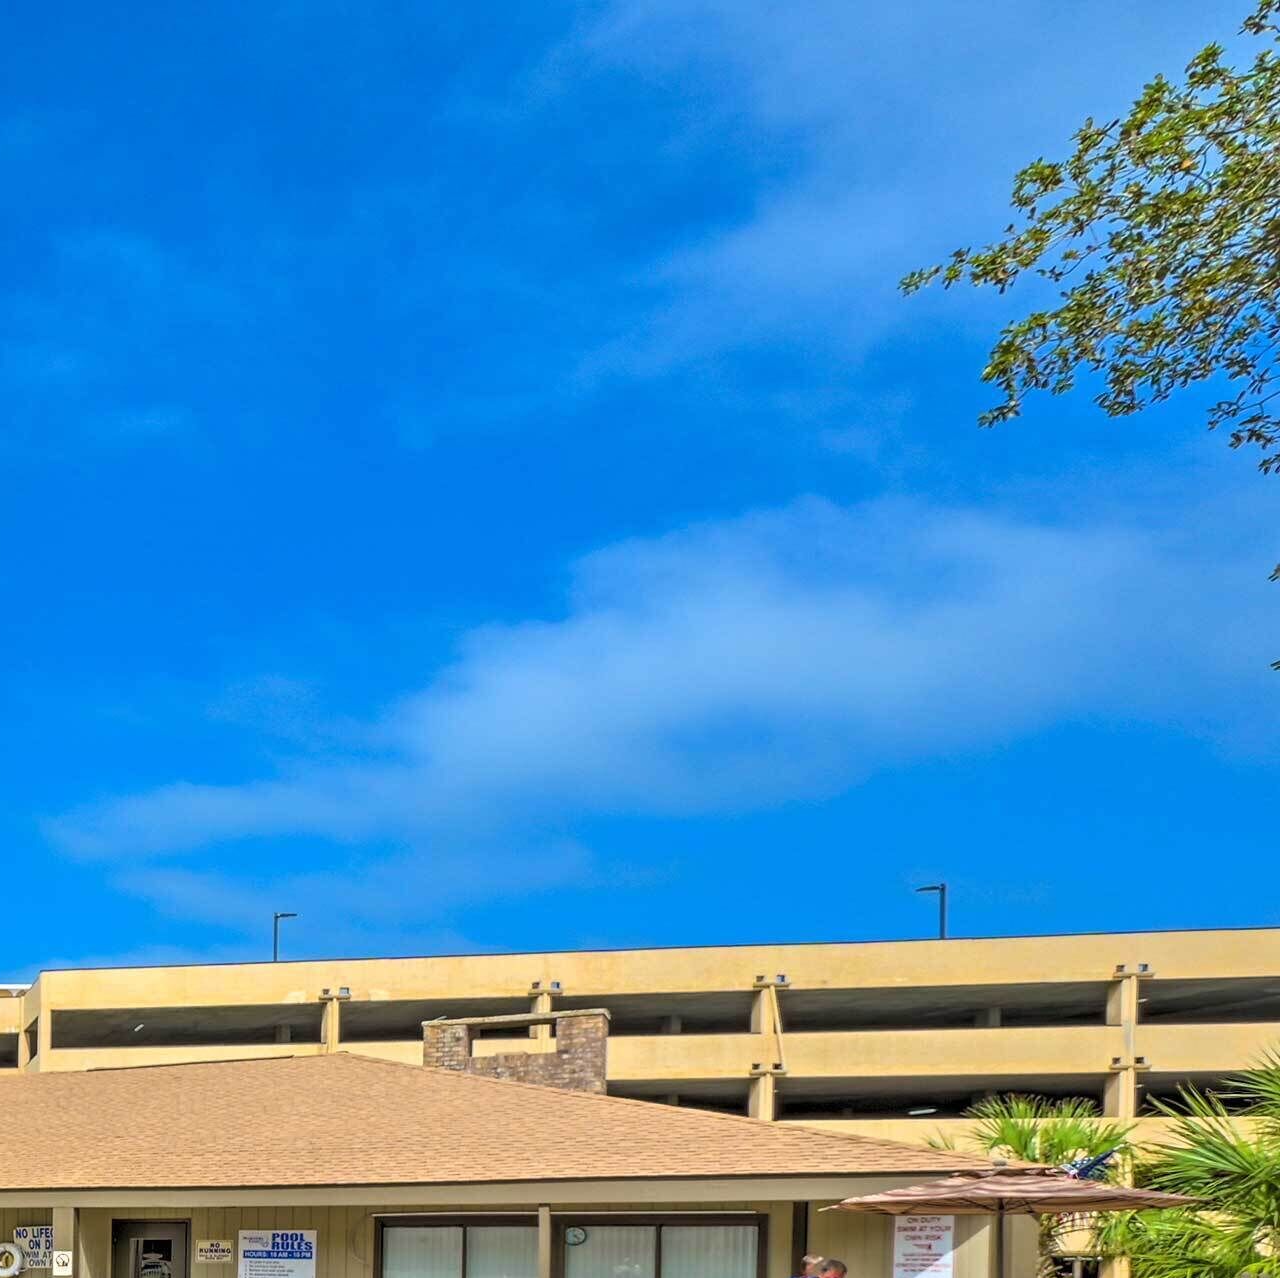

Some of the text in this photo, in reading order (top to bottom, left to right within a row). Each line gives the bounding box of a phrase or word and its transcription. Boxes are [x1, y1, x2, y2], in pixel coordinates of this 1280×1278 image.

[16, 1228, 53, 1239] NO LIFE
[272, 1233, 306, 1242] POOL
[29, 1239, 40, 1250] ON
[271, 1242, 313, 1251] RULES
[43, 1251, 52, 1259] AT
[29, 1259, 46, 1267] OWN
